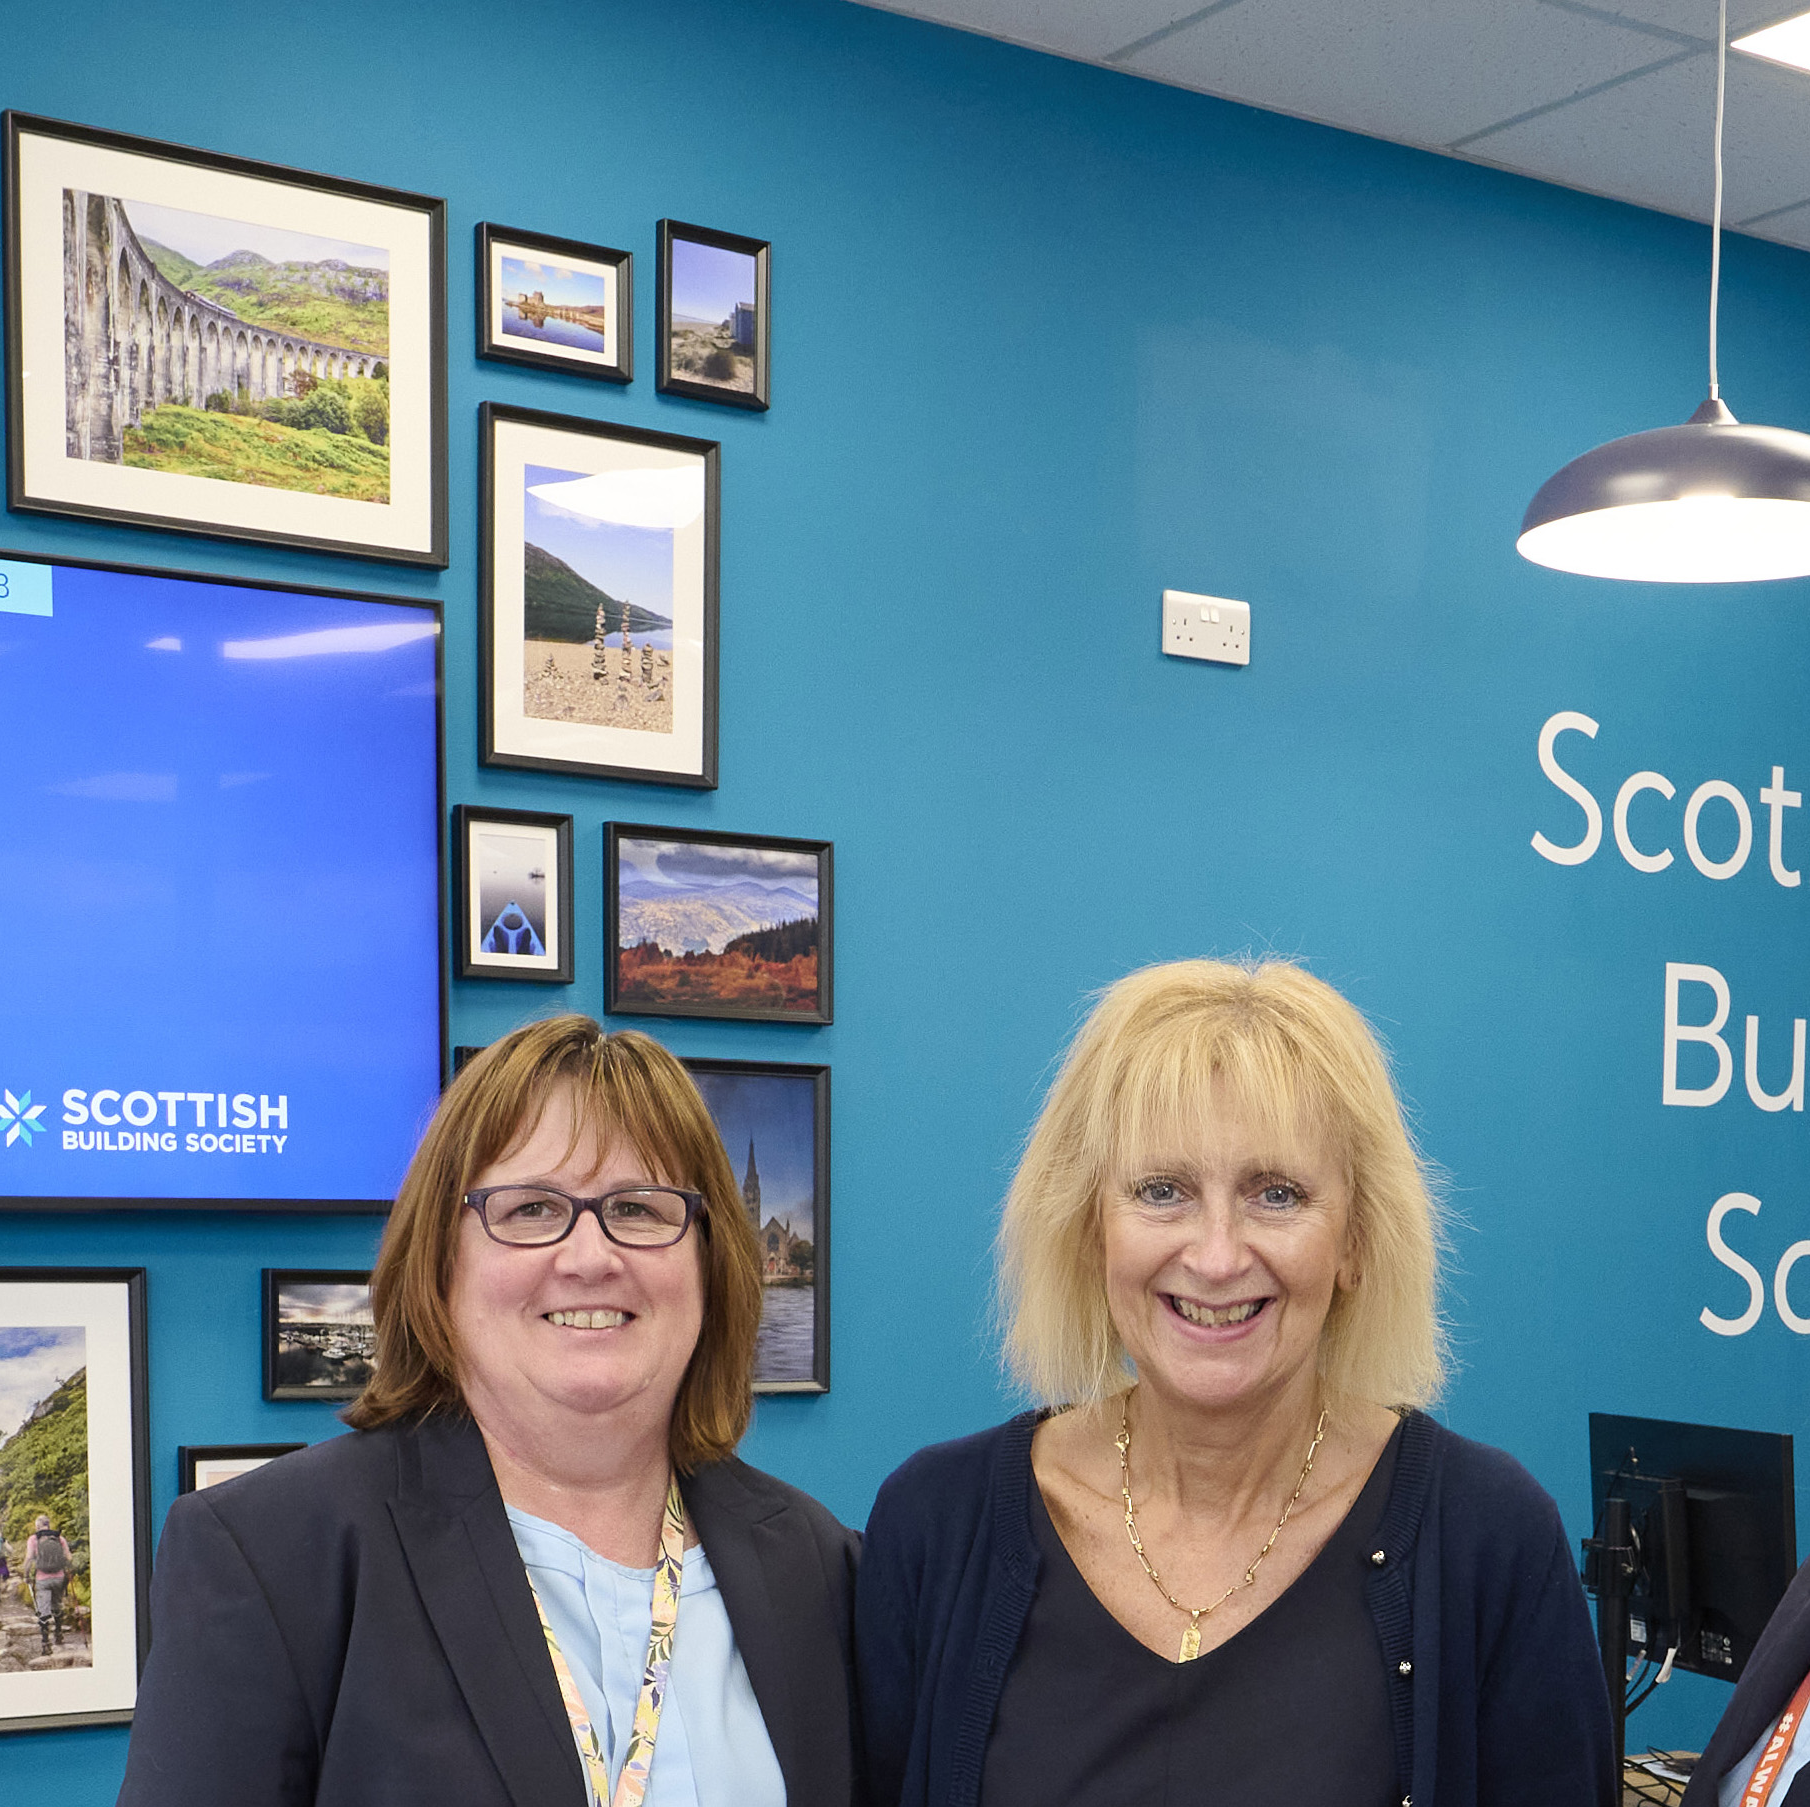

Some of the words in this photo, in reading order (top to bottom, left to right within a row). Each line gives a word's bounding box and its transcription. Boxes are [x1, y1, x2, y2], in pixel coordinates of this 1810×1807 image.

[62, 1088, 288, 1130] SCOTTISH
[62, 1130, 178, 1152] BUILDING
[185, 1133, 288, 1154] SOCIETY
